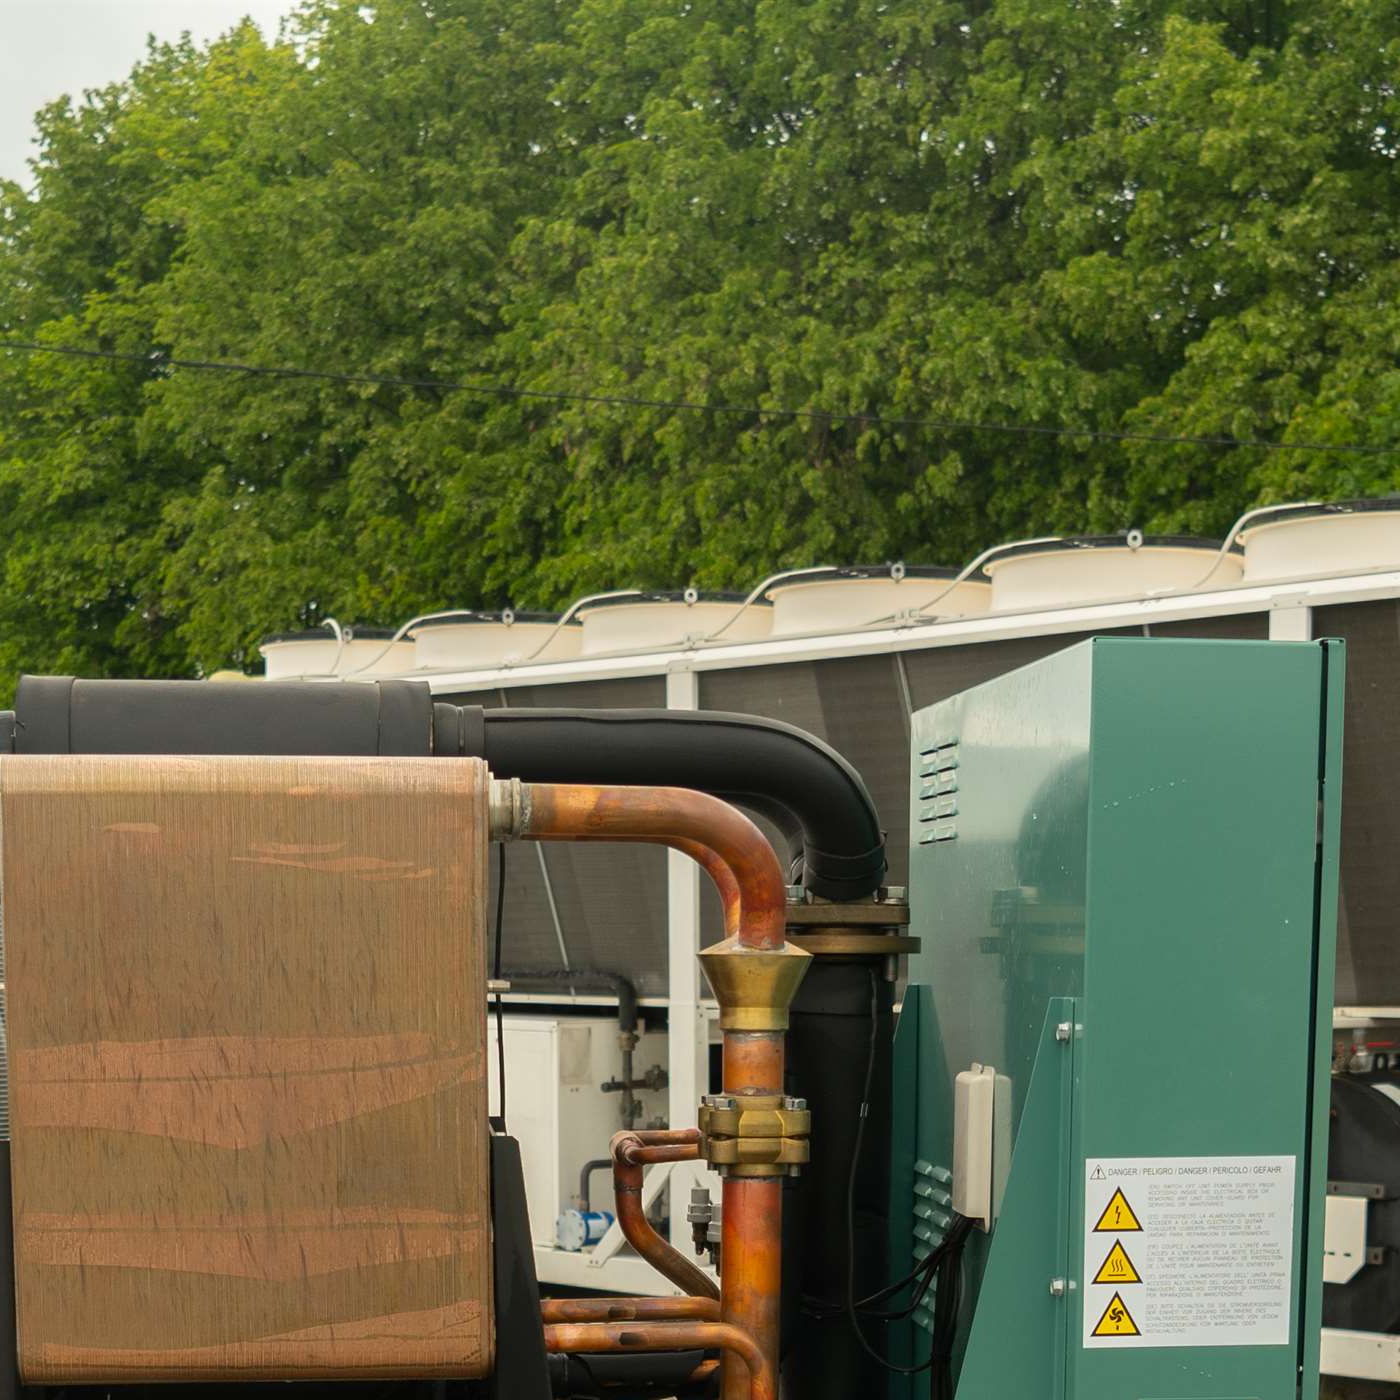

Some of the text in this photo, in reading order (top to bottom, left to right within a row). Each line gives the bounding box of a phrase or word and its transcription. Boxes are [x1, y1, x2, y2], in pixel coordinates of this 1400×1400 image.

[1108, 1167, 1138, 1176] DANGER
[1143, 1167, 1174, 1176] PELIGRO
[1179, 1167, 1208, 1175] DANGER
[1213, 1166, 1249, 1175] PERICOLO
[1253, 1165, 1281, 1174] GEFAHR
